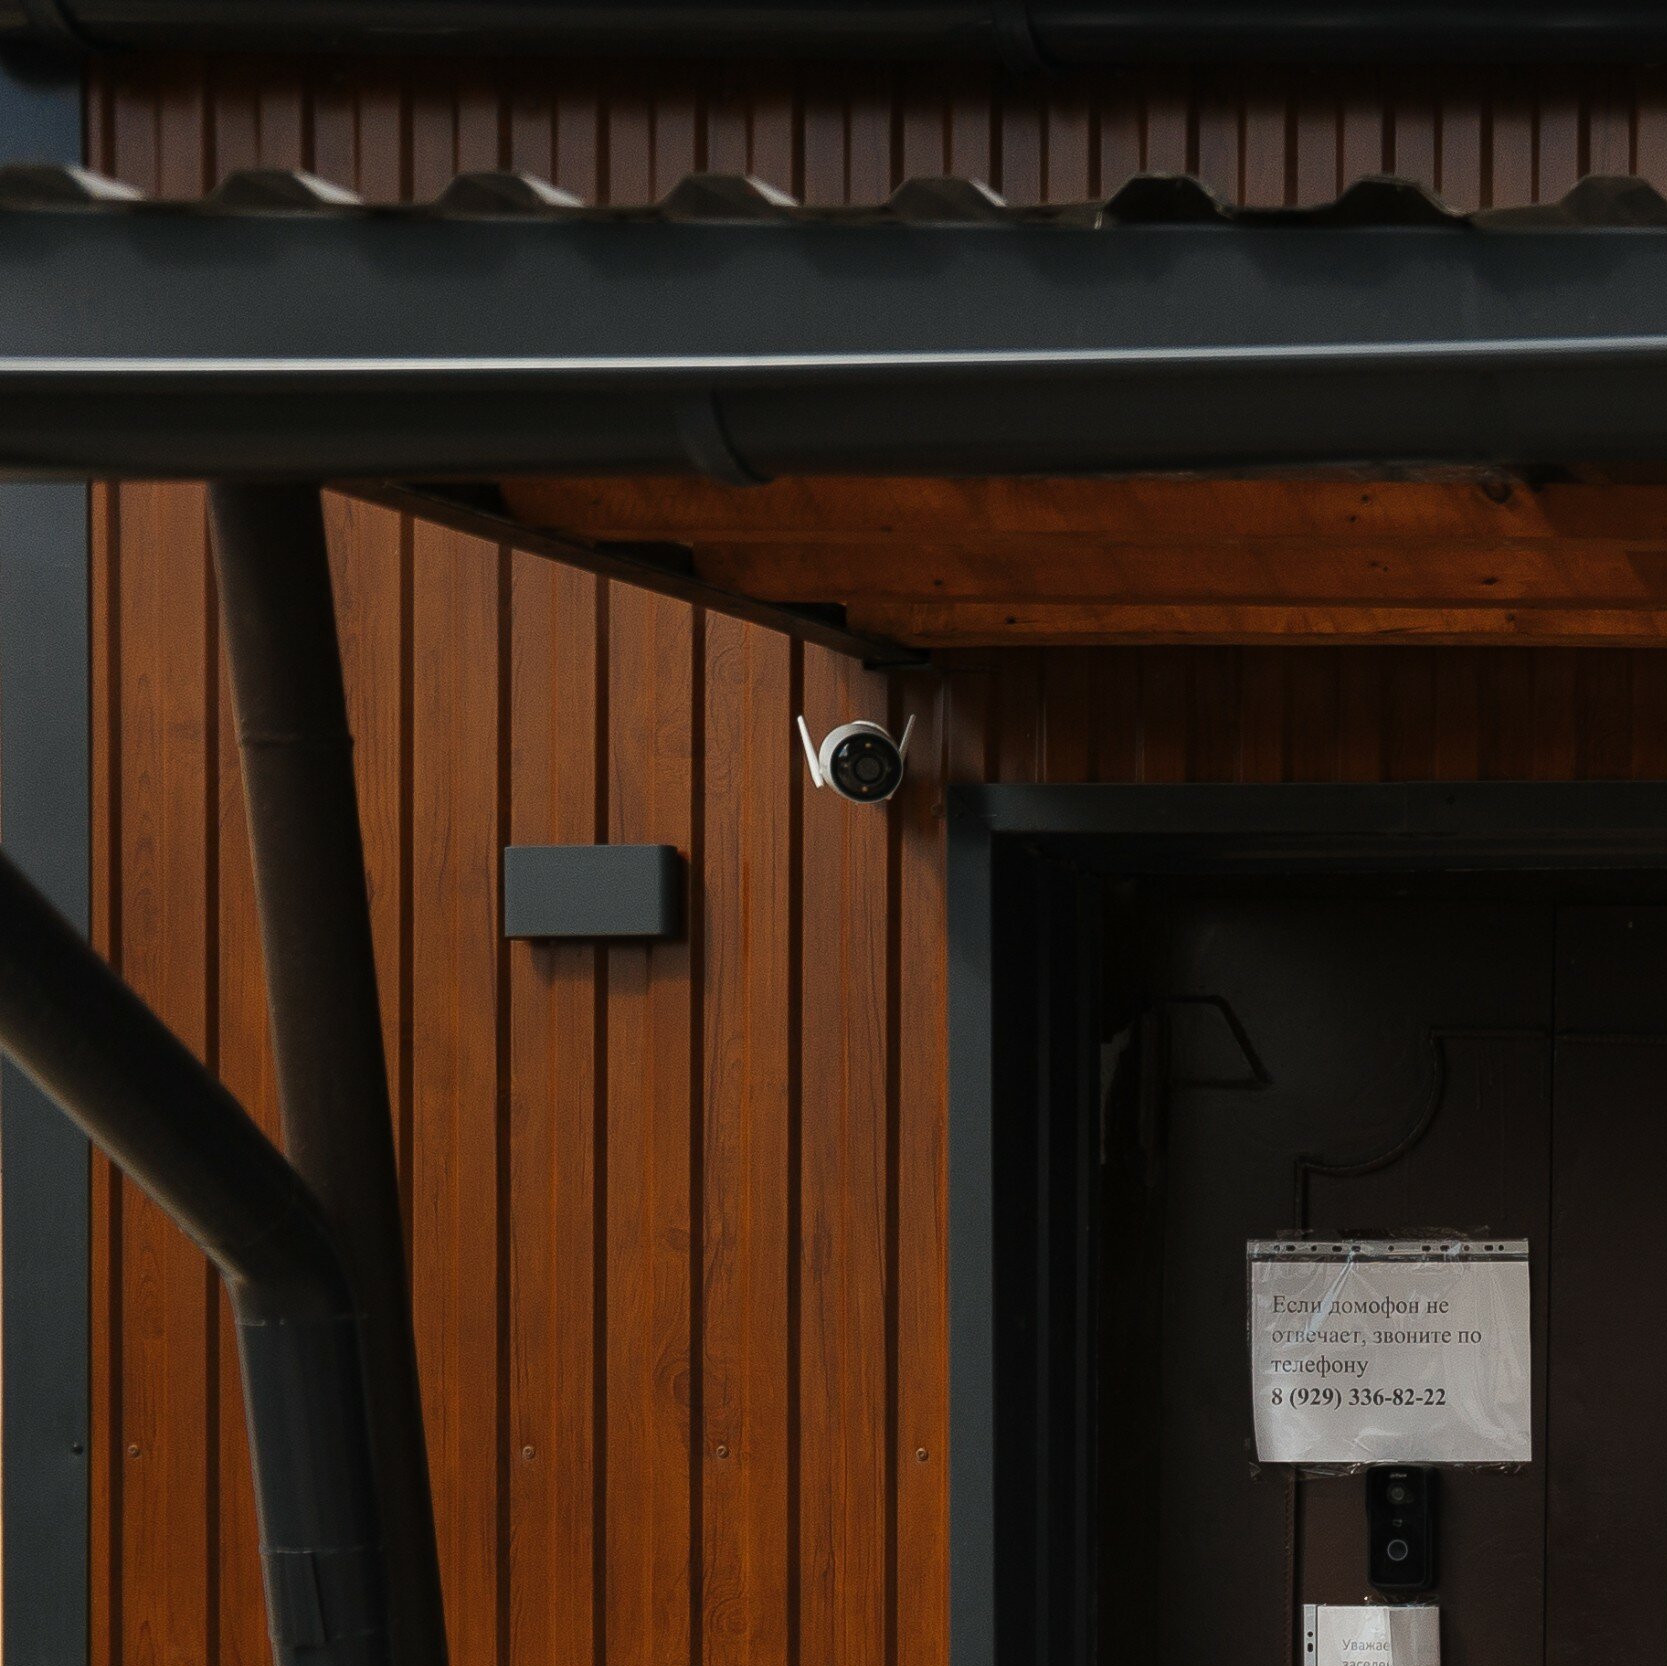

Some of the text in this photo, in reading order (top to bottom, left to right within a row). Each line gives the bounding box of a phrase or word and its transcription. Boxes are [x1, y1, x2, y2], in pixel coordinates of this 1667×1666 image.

[1272, 1295, 1449, 1318] Если домофон не
[1272, 1330, 1482, 1347] отвечает, звоните по
[1271, 1354, 1369, 1377] телефону
[1271, 1387, 1447, 1411] 8 (929) 336-82-22
